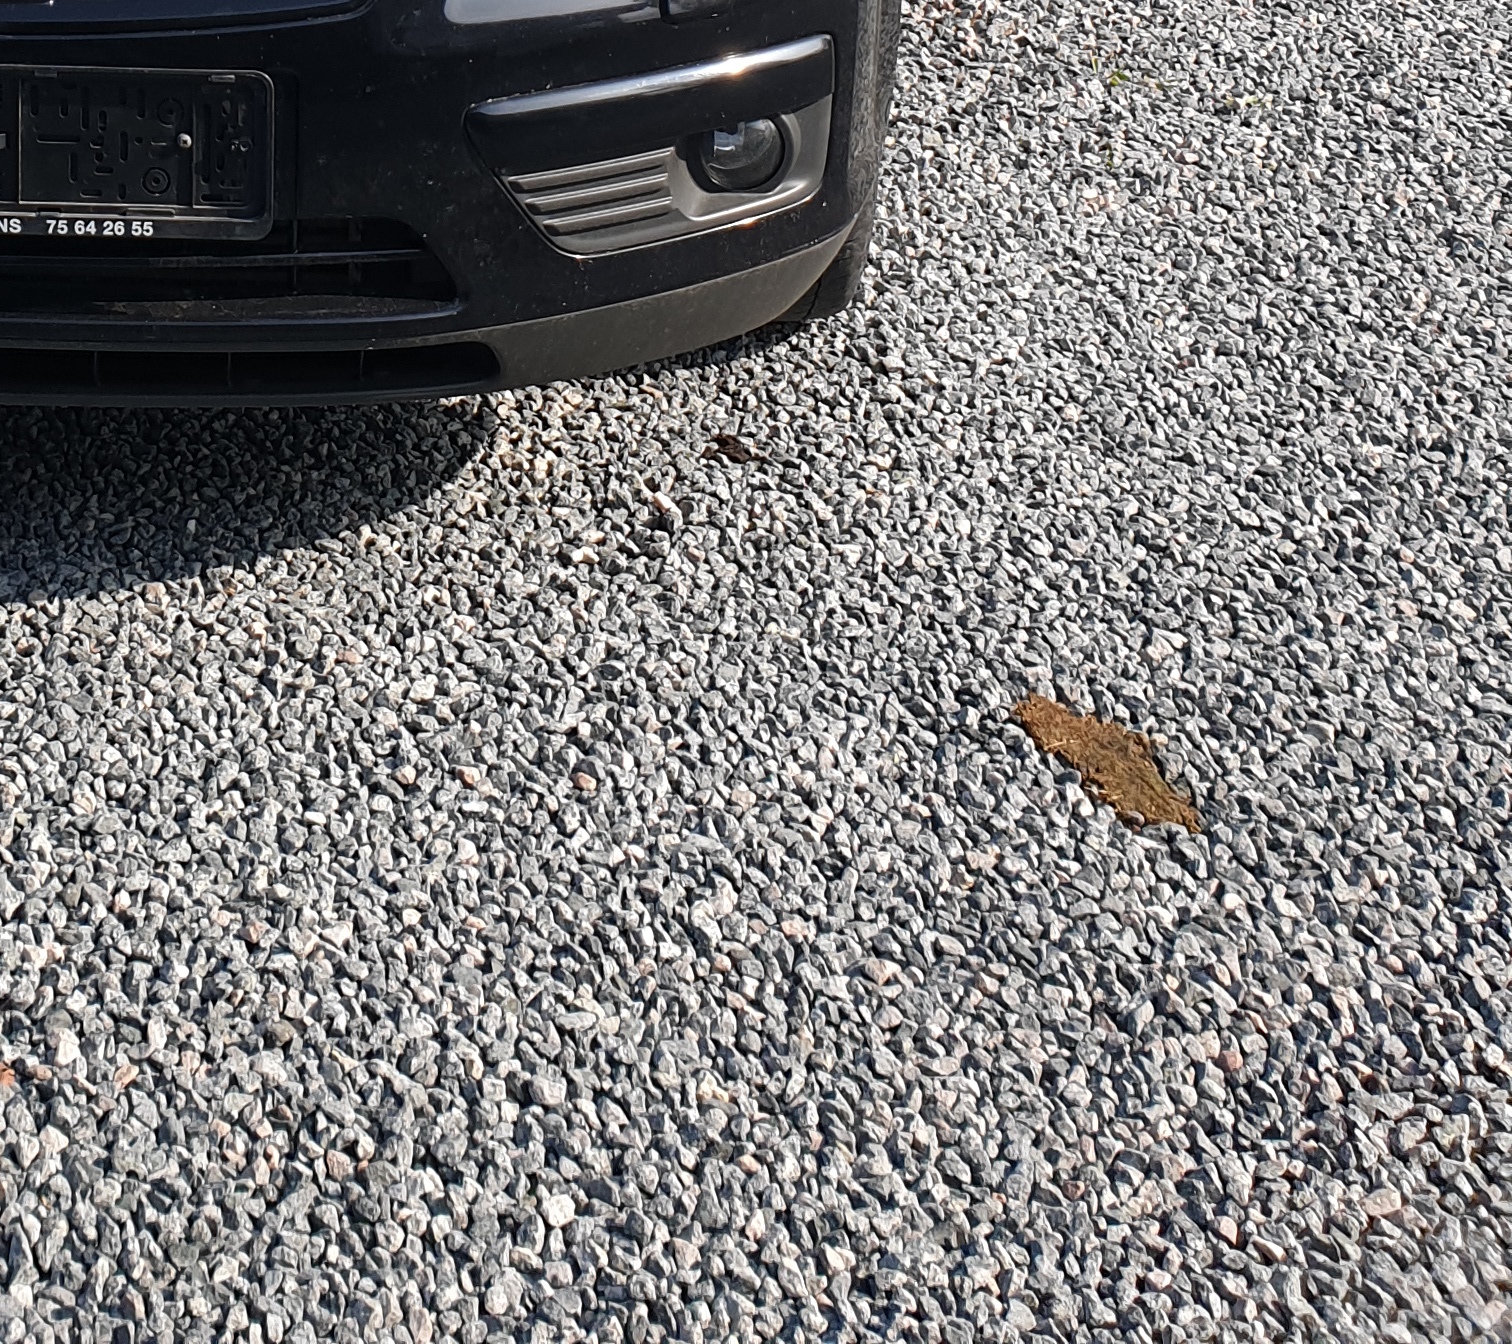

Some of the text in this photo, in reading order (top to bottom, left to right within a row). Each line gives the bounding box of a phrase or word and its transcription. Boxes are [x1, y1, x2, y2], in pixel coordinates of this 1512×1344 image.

[45, 219, 69, 235] 75
[74, 219, 97, 236] 64
[102, 220, 125, 237] 26
[131, 220, 154, 238] 55
